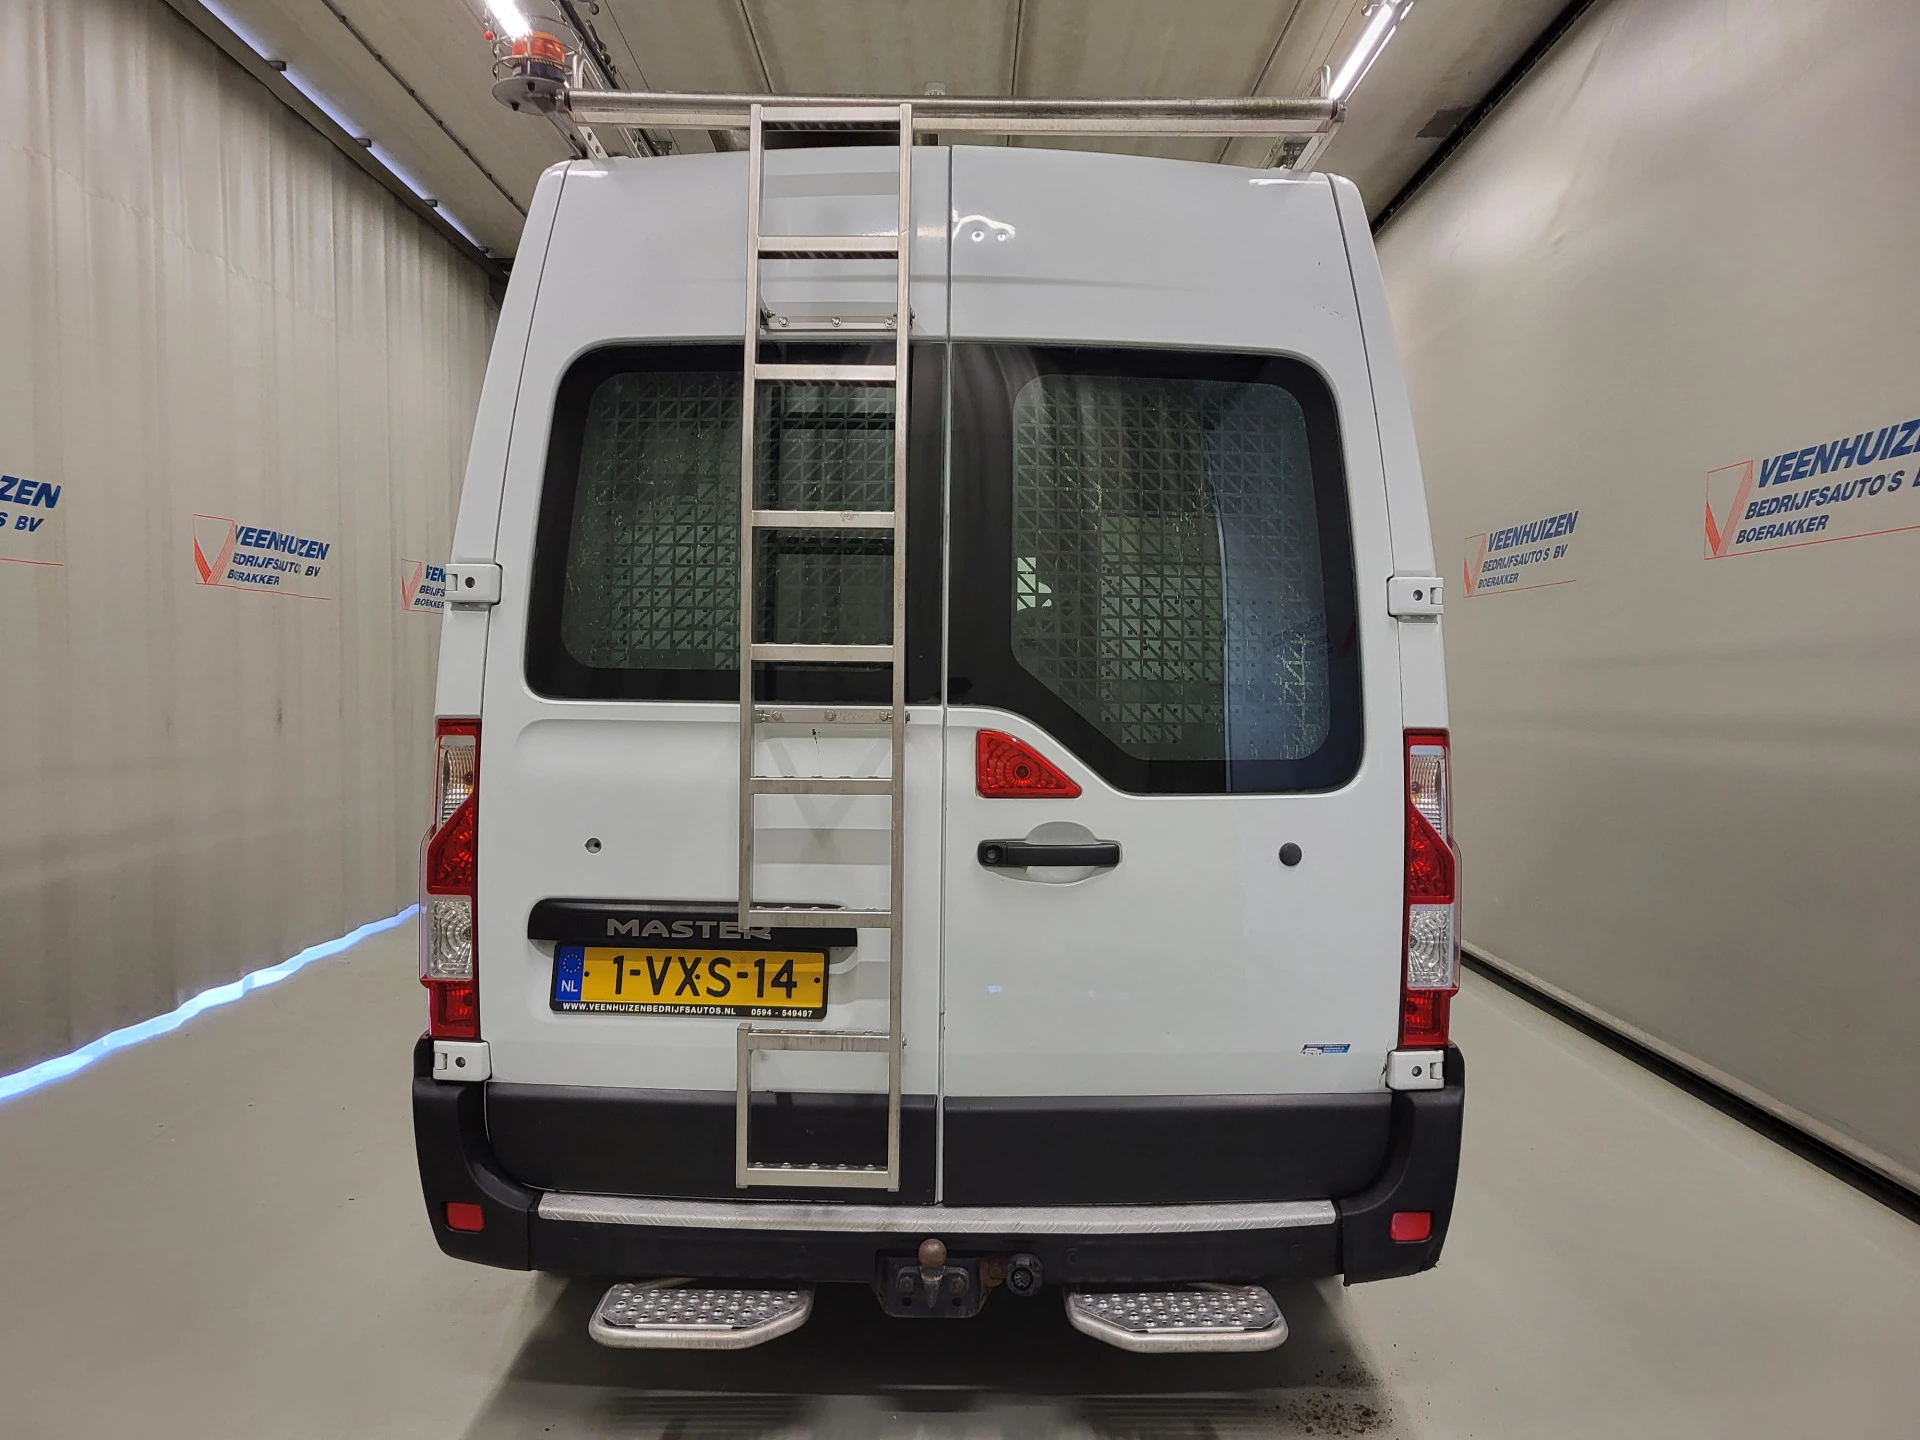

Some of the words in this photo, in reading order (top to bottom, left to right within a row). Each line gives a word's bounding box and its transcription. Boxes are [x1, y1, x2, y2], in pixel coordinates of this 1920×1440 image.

[1744, 469, 1905, 520] BEDRIJFSAUTO'S
[14, 515, 45, 532] BV
[1487, 510, 1579, 553] VEENHUIZEN
[1735, 514, 1830, 545] BOERAKKER
[1481, 547, 1551, 573] BEDRIJFSAUTO'S
[1553, 543, 1569, 559] BV
[304, 565, 321, 577] BV
[1477, 572, 1519, 588] BOERAKKER
[561, 979, 579, 992] NL
[612, 955, 798, 999] 1-VXS-14
[562, 1002, 737, 1016] WWW.VEENHUIZENBEDRIJFSAUTOS.NL
[751, 1007, 772, 1017] 0594
[781, 1008, 813, 1018] 549497
